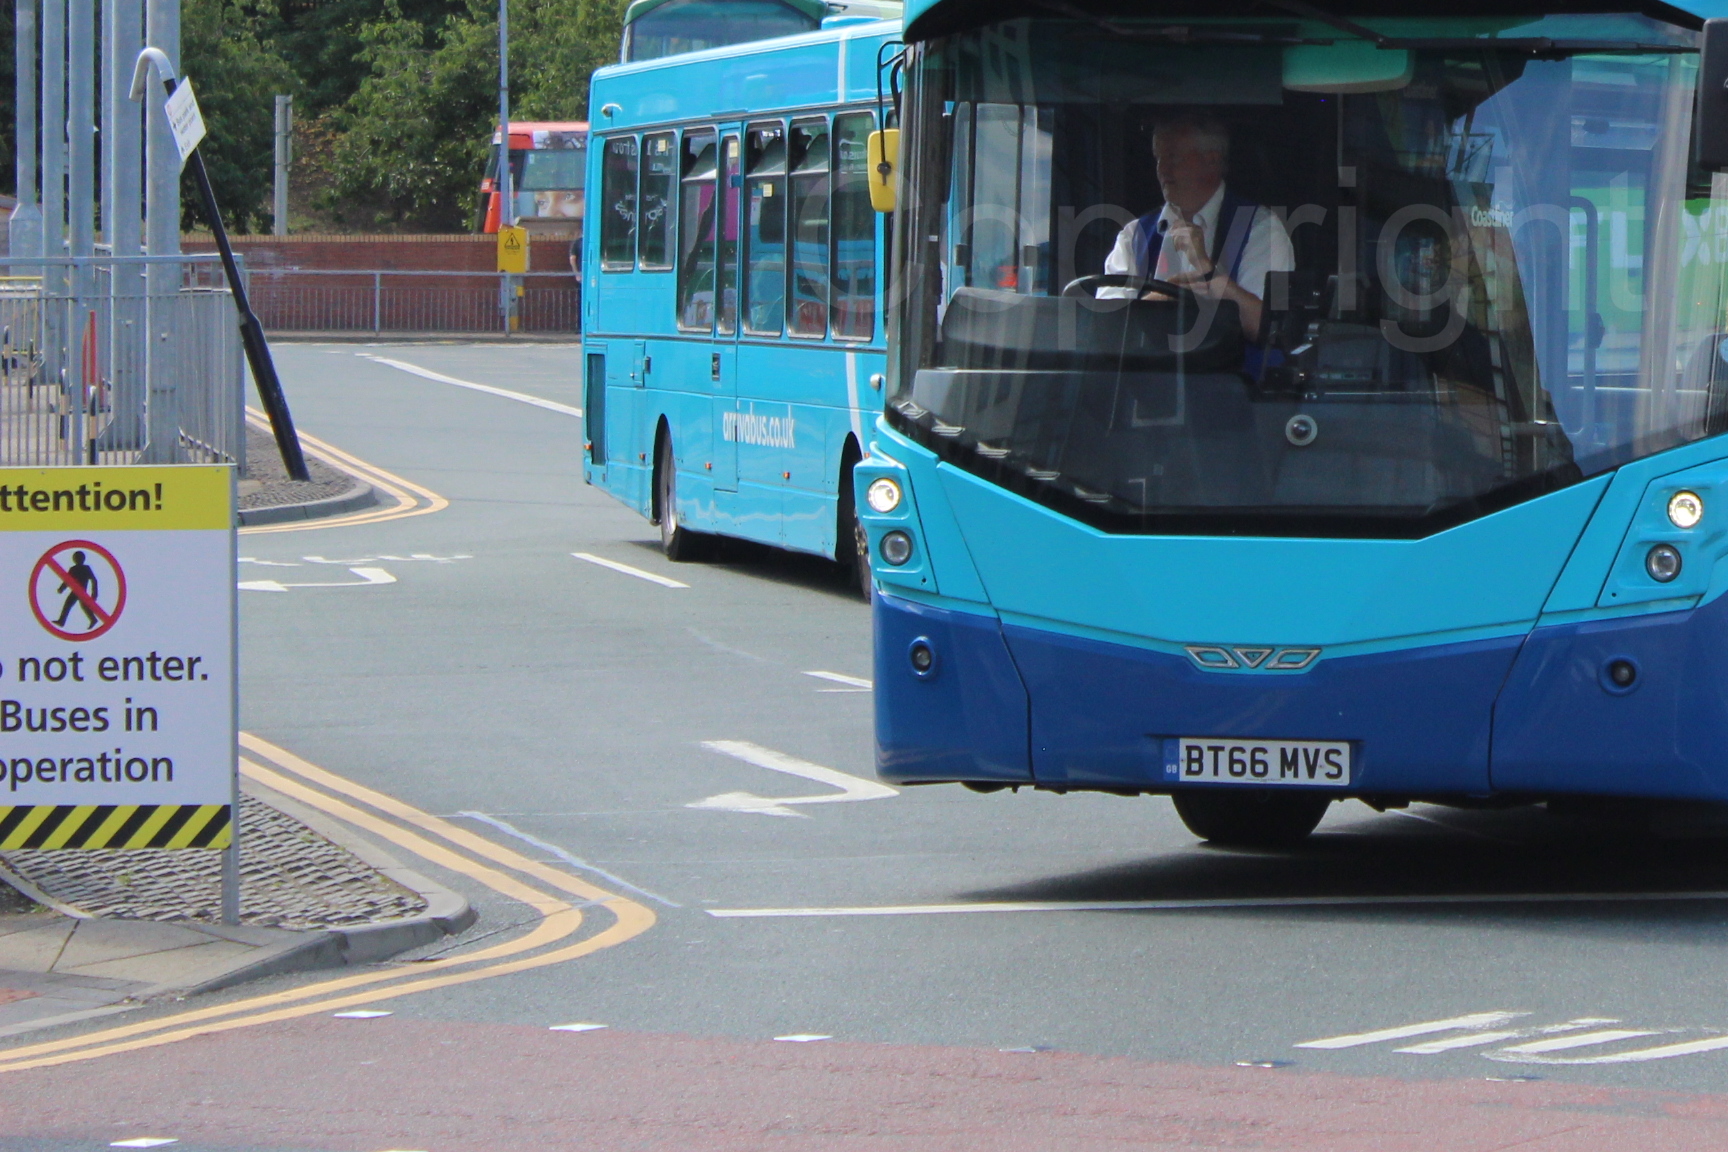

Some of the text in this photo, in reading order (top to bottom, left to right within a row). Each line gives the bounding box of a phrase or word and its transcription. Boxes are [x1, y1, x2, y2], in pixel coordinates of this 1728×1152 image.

[722, 401, 796, 449] arrivabus.co.uk
[0, 481, 163, 512] ttention!
[18, 650, 84, 683] not
[97, 650, 209, 683] enter.
[0, 697, 158, 733] Buses in
[1166, 764, 1178, 774] GB
[1185, 745, 1343, 780] BT66 MVS
